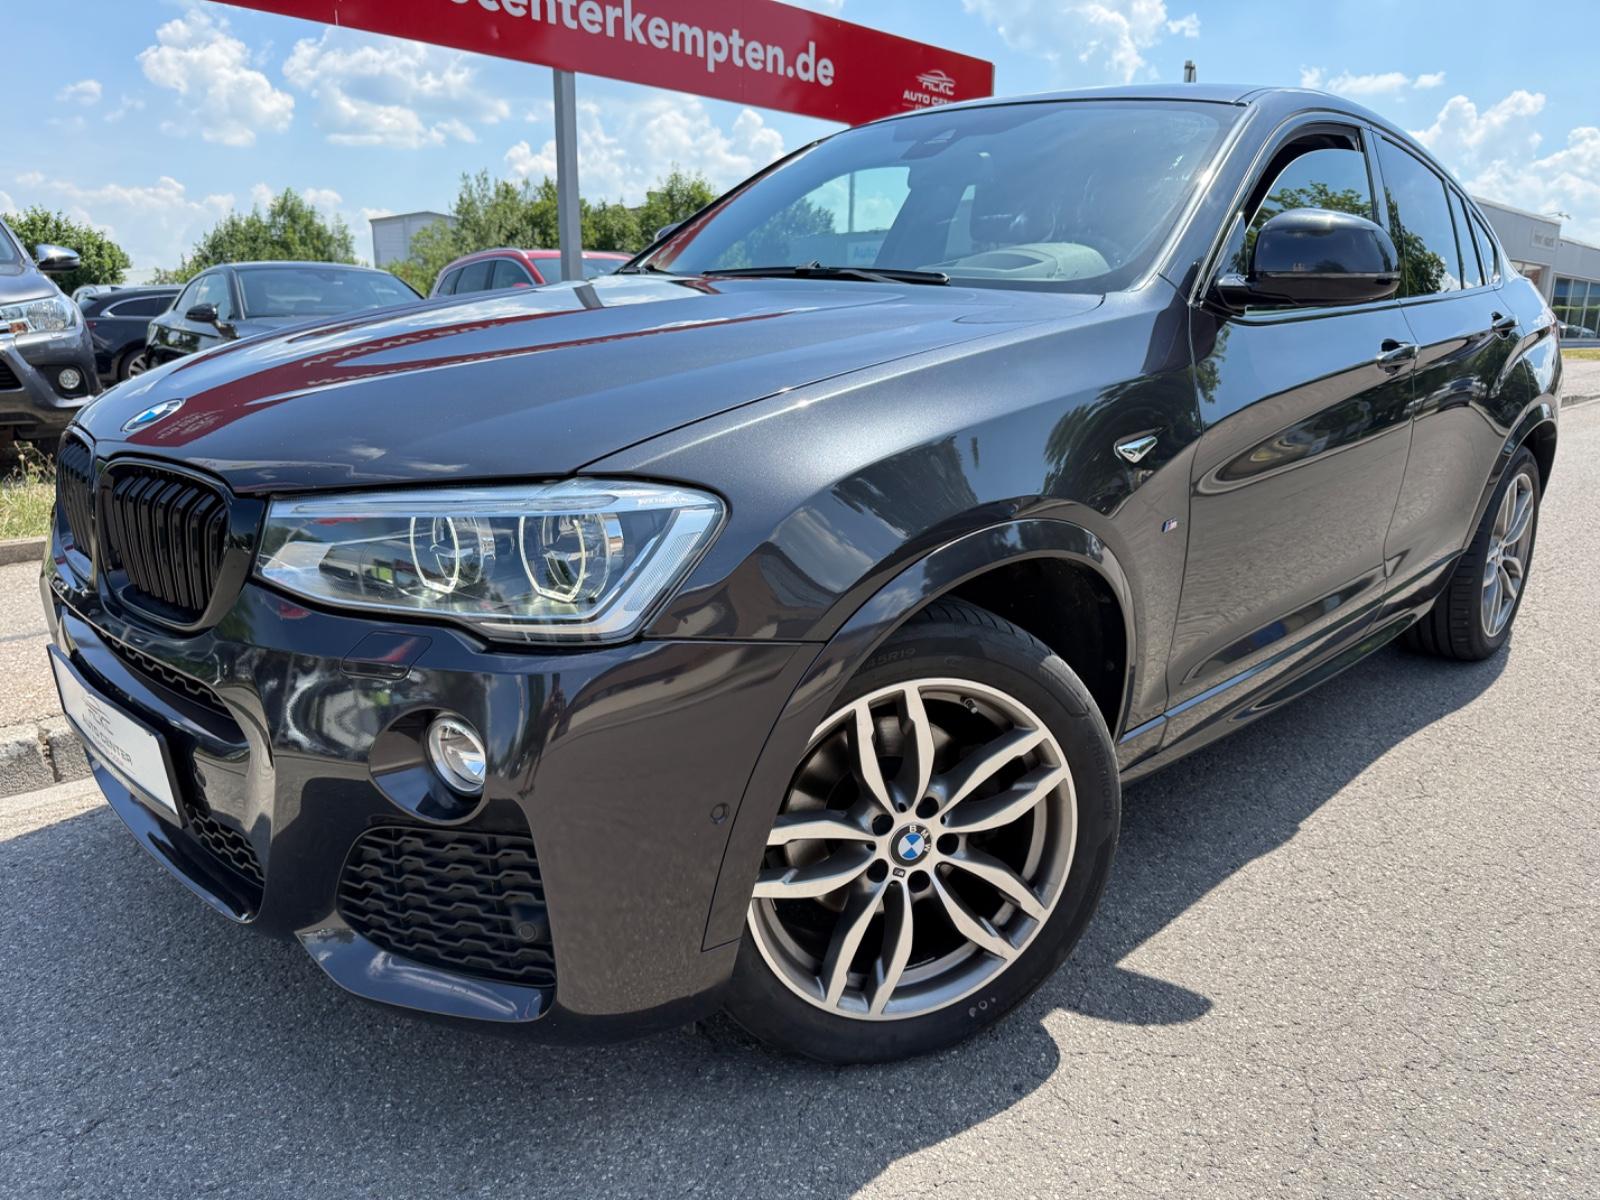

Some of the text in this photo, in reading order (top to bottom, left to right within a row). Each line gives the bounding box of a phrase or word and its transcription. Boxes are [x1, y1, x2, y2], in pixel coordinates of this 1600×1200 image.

[453, 0, 835, 87] enterkempten.de
[902, 90, 931, 105] AUTO
[908, 824, 932, 853] BMW
